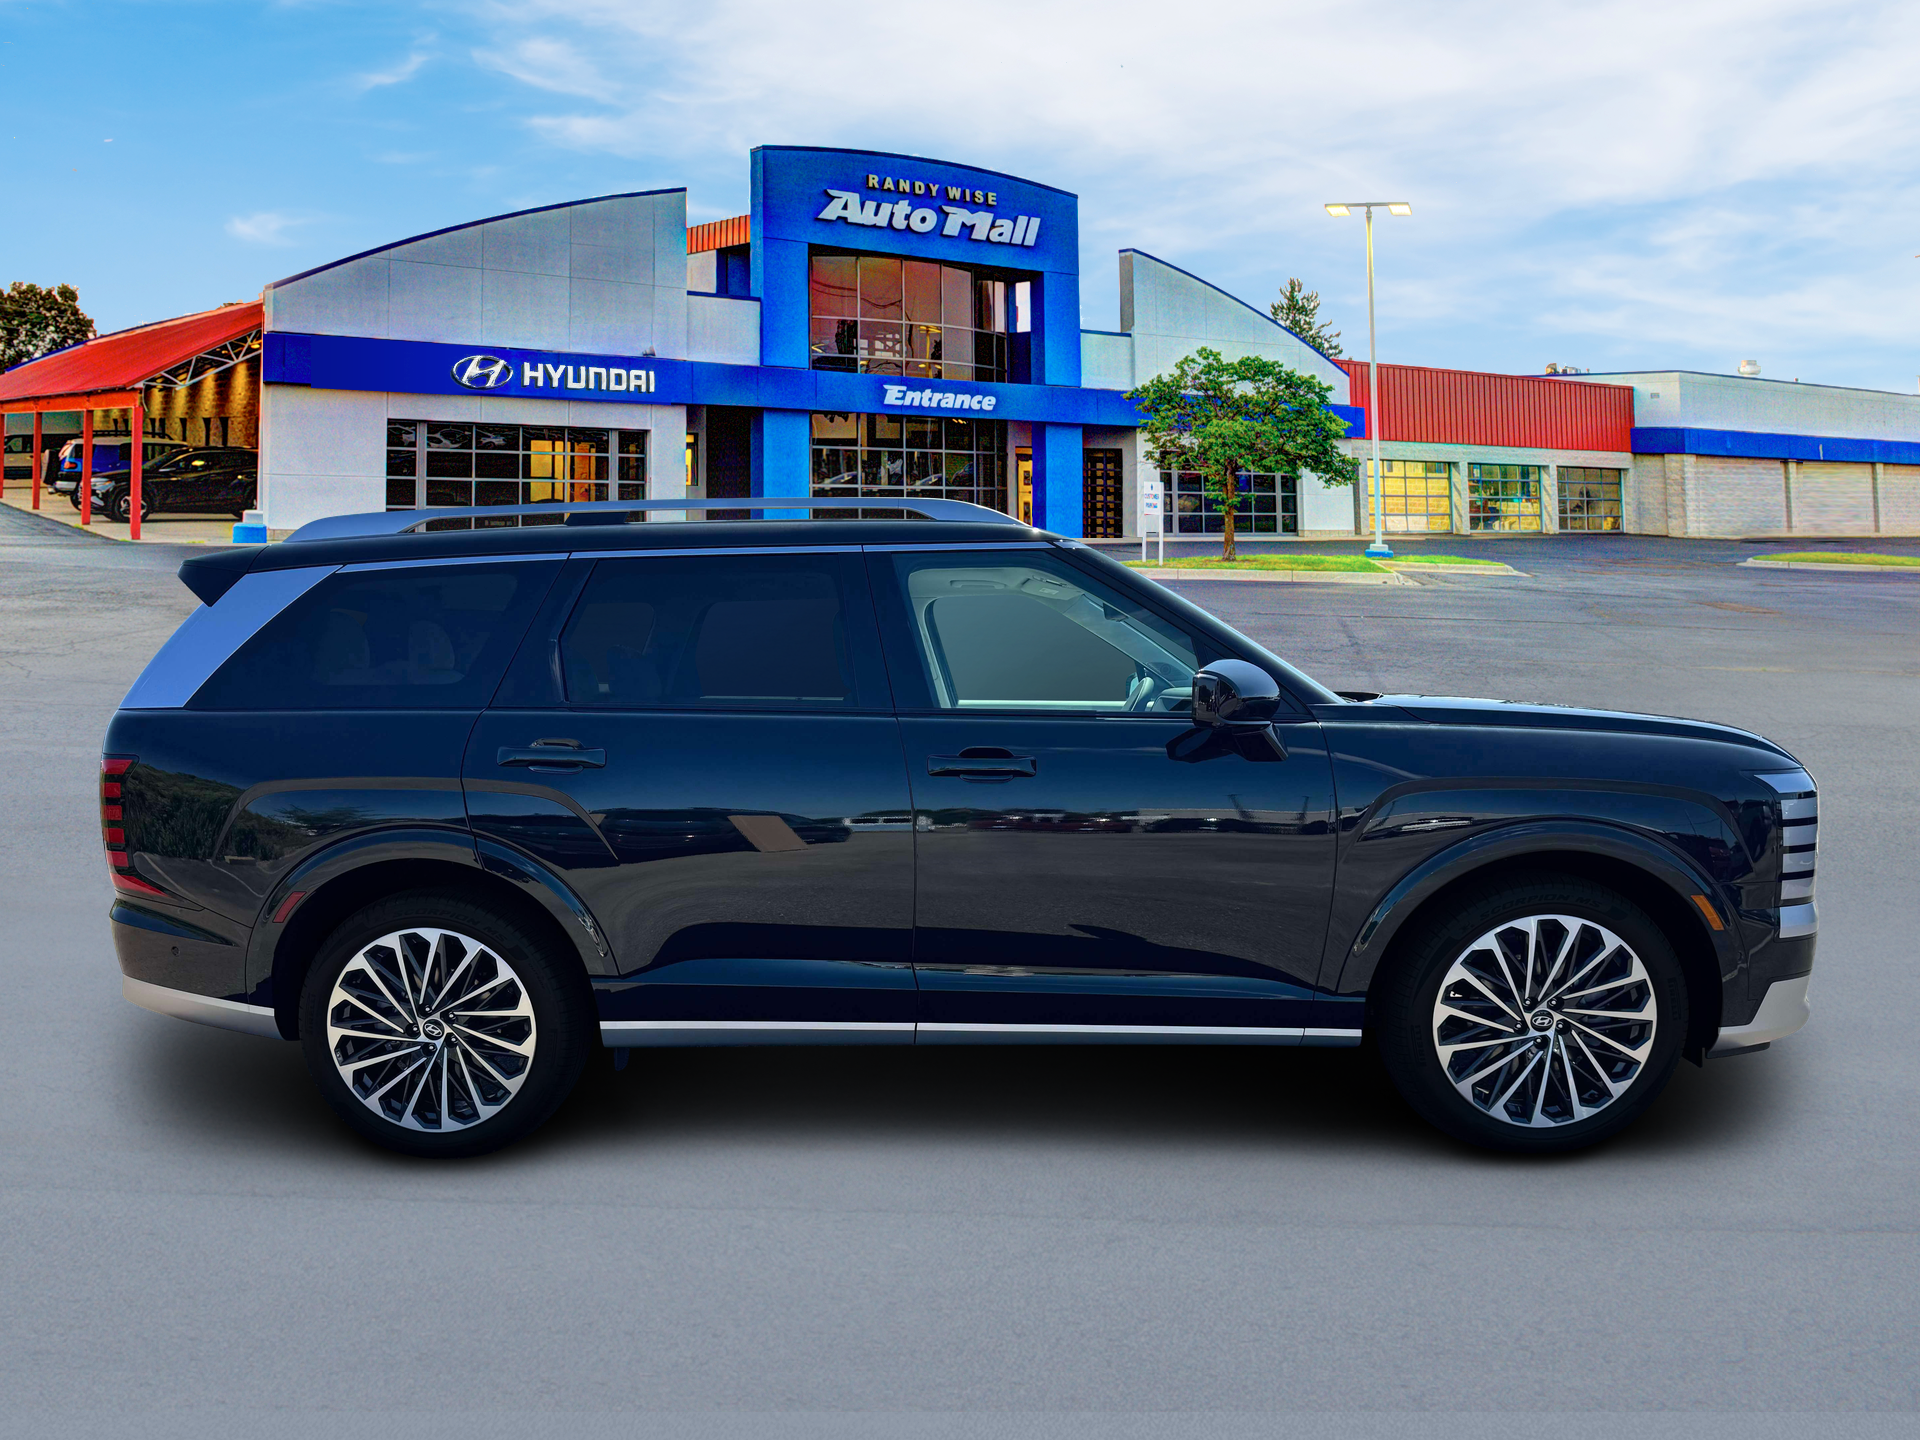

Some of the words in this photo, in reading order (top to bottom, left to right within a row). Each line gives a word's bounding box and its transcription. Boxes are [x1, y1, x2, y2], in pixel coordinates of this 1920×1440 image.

[867, 174, 940, 197] RANDY
[946, 186, 998, 206] WISE
[817, 188, 938, 233] Auto
[941, 205, 1041, 247] Mall
[522, 362, 656, 393] HYUNDAI
[883, 384, 997, 412] Entrance
[1480, 893, 1570, 921] SCORPION
[1575, 896, 1604, 909] MS
